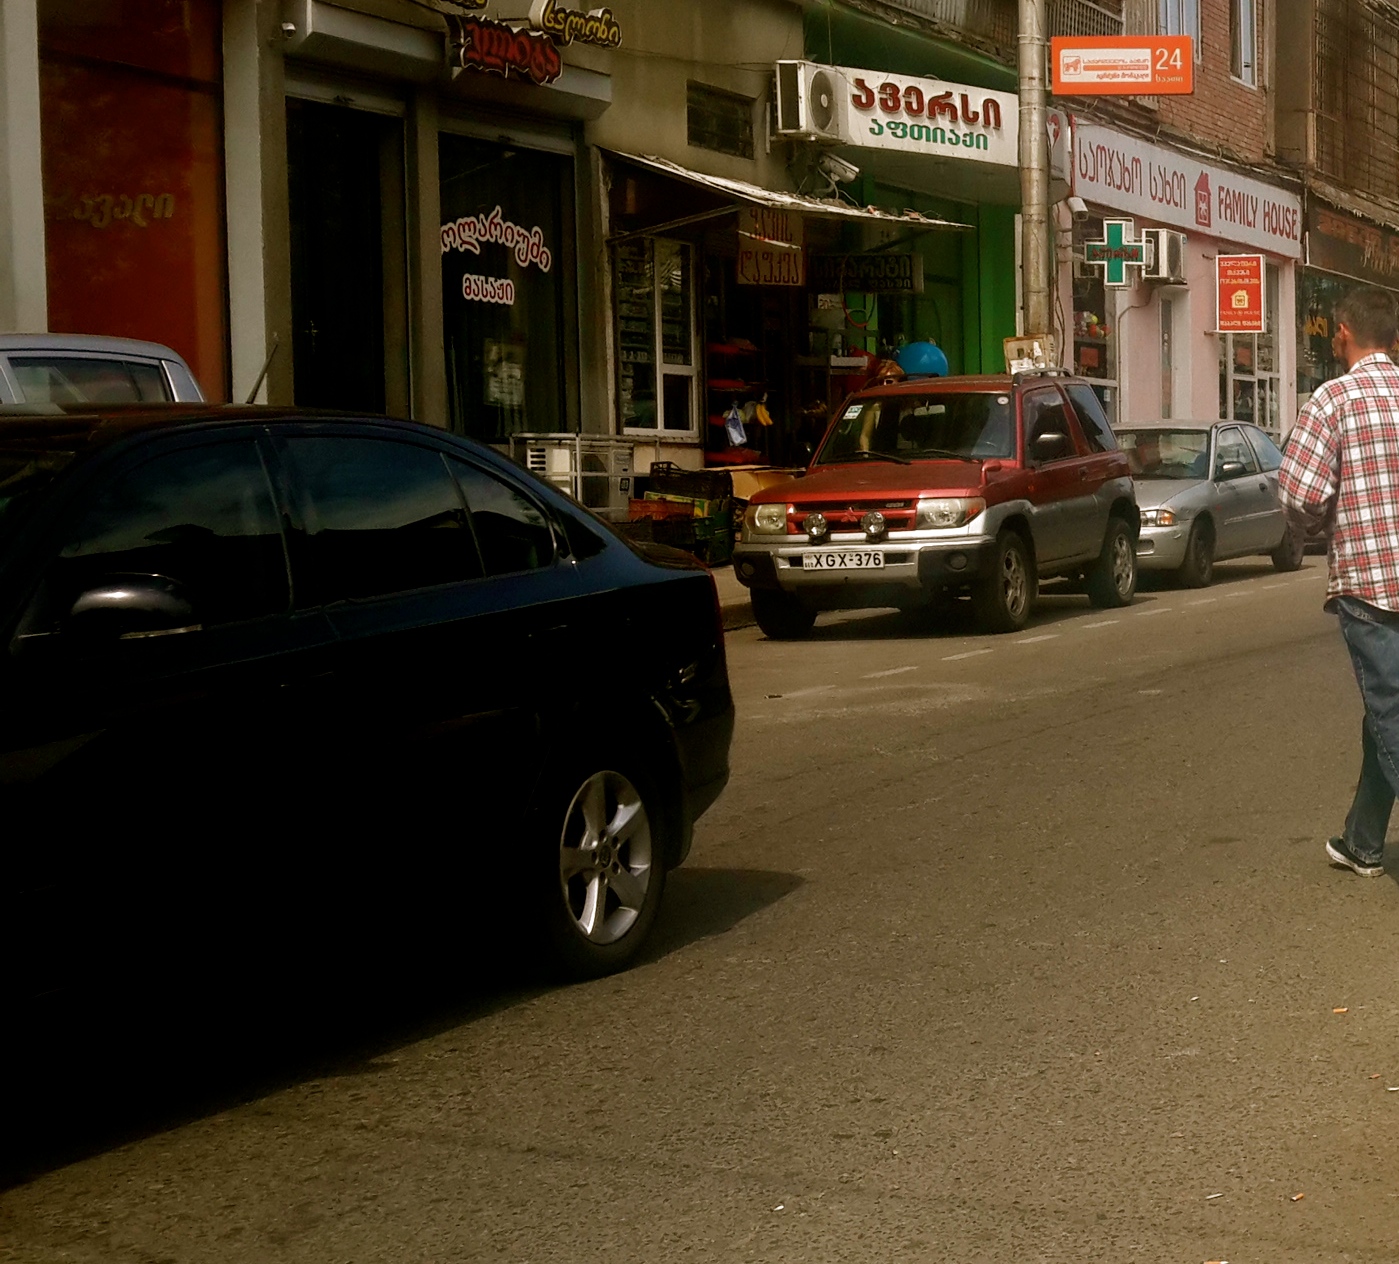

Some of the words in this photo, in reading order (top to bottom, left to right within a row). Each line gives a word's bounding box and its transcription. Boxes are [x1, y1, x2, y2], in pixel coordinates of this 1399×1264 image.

[1155, 48, 1183, 70] 24
[851, 77, 1002, 130] ავერსი
[869, 118, 989, 151] აფთიაქი
[1078, 137, 1143, 197] საოჯახო
[1149, 161, 1187, 210] სახლი
[1218, 185, 1258, 229] FAMILY
[1263, 200, 1298, 241] HOUSE
[440, 206, 551, 273] ოლარიუმი
[463, 273, 514, 305] მასაჟი
[814, 552, 881, 568] XGX-376
